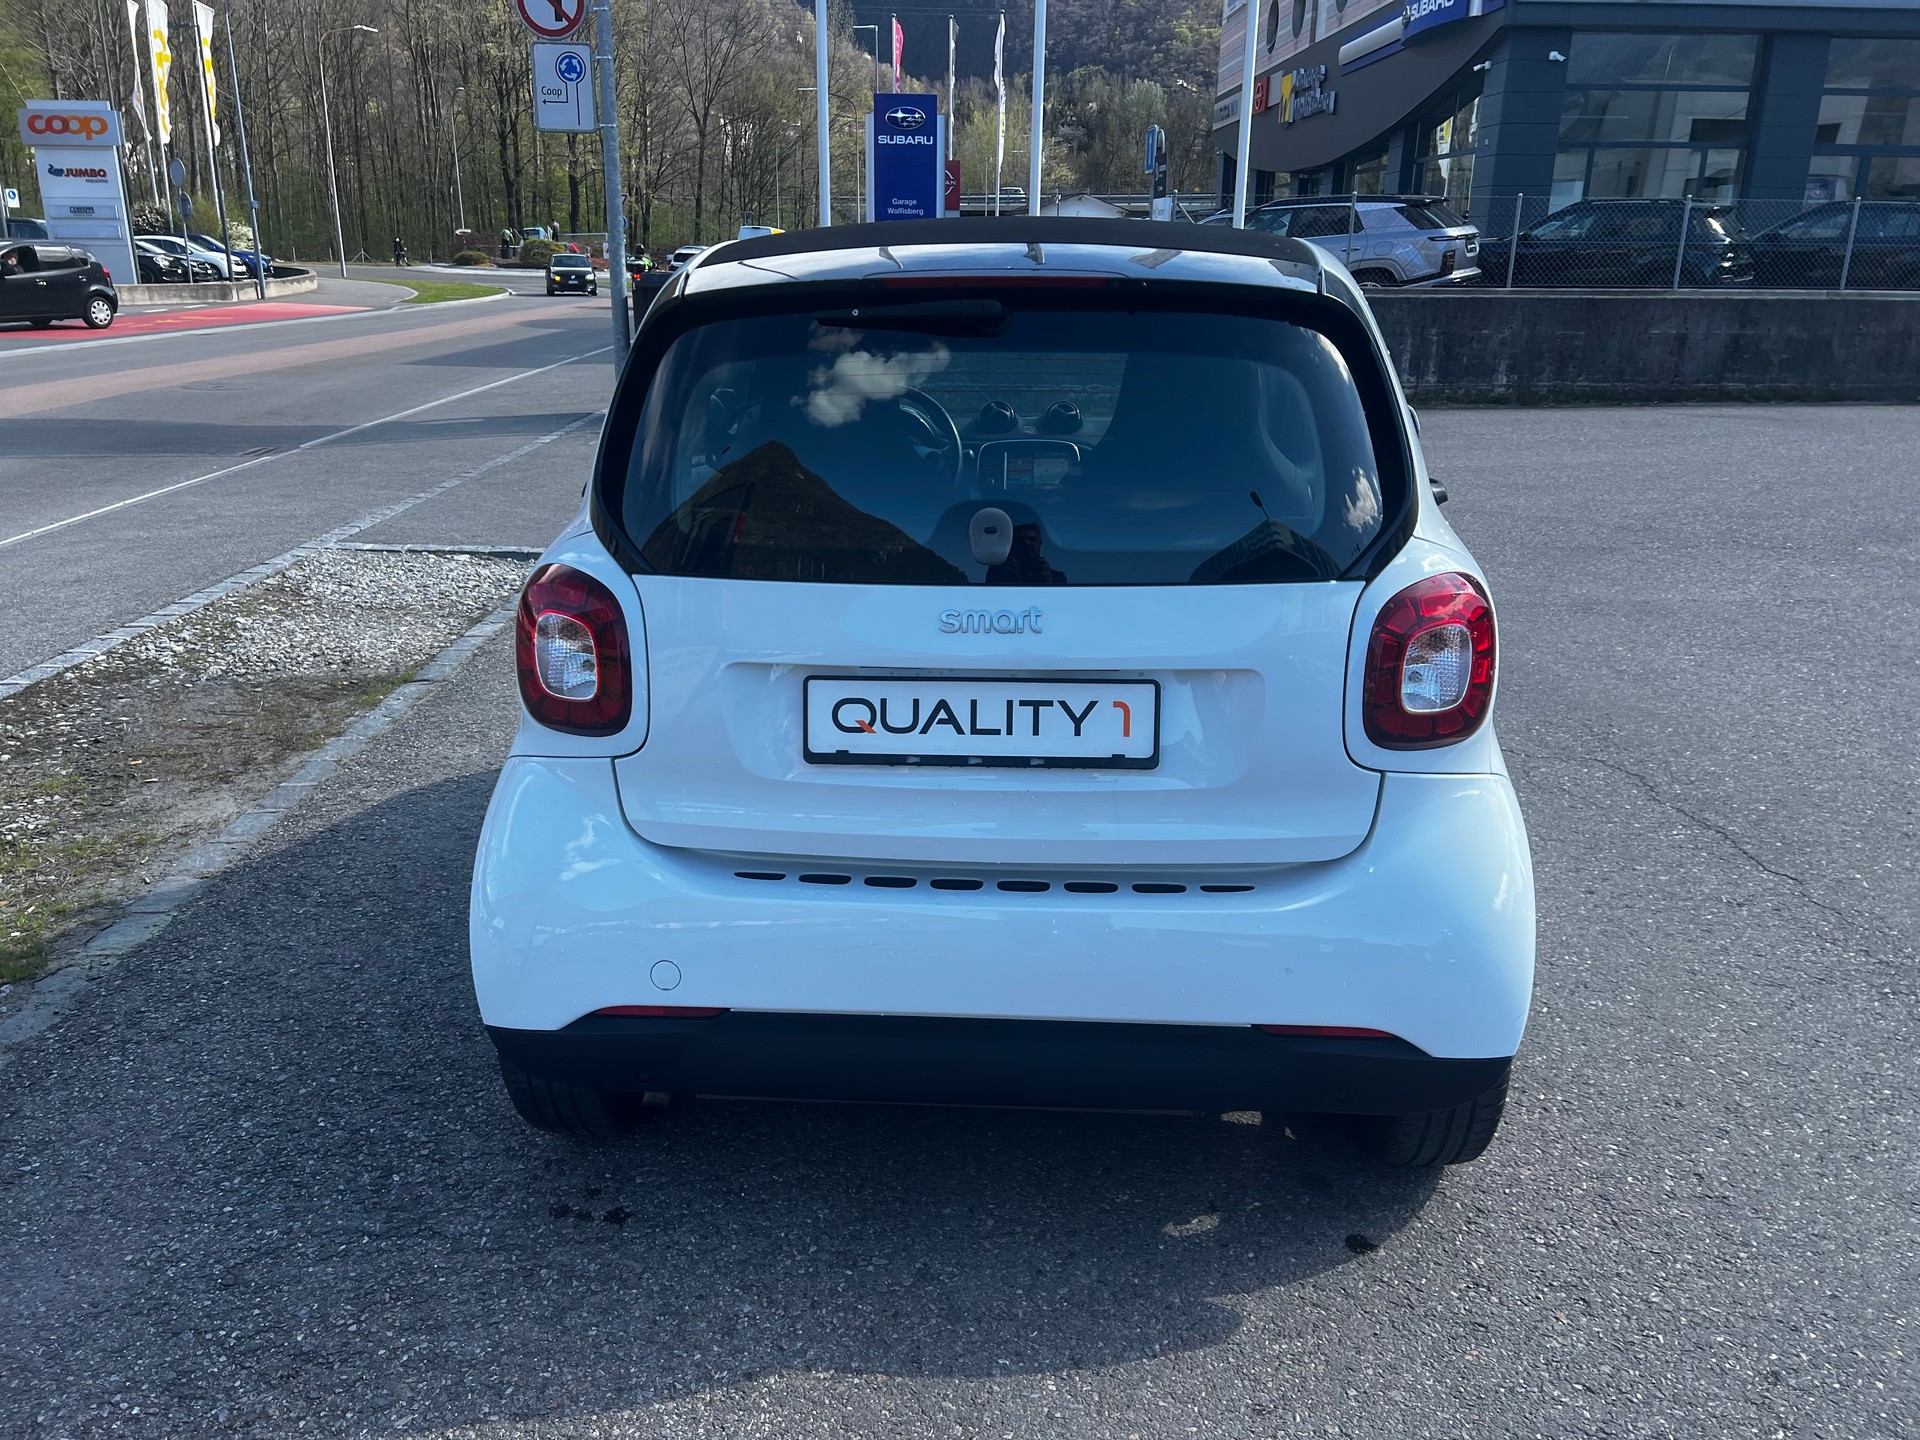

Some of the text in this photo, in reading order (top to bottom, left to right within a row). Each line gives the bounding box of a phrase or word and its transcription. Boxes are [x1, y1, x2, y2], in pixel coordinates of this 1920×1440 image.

[541, 86, 563, 98] Coop
[27, 114, 108, 141] coop
[877, 135, 934, 145] SUBARU
[64, 168, 107, 178] JUMBO
[891, 197, 918, 207] Garage
[887, 207, 925, 216] Wolfisberg
[938, 606, 1043, 634] smart
